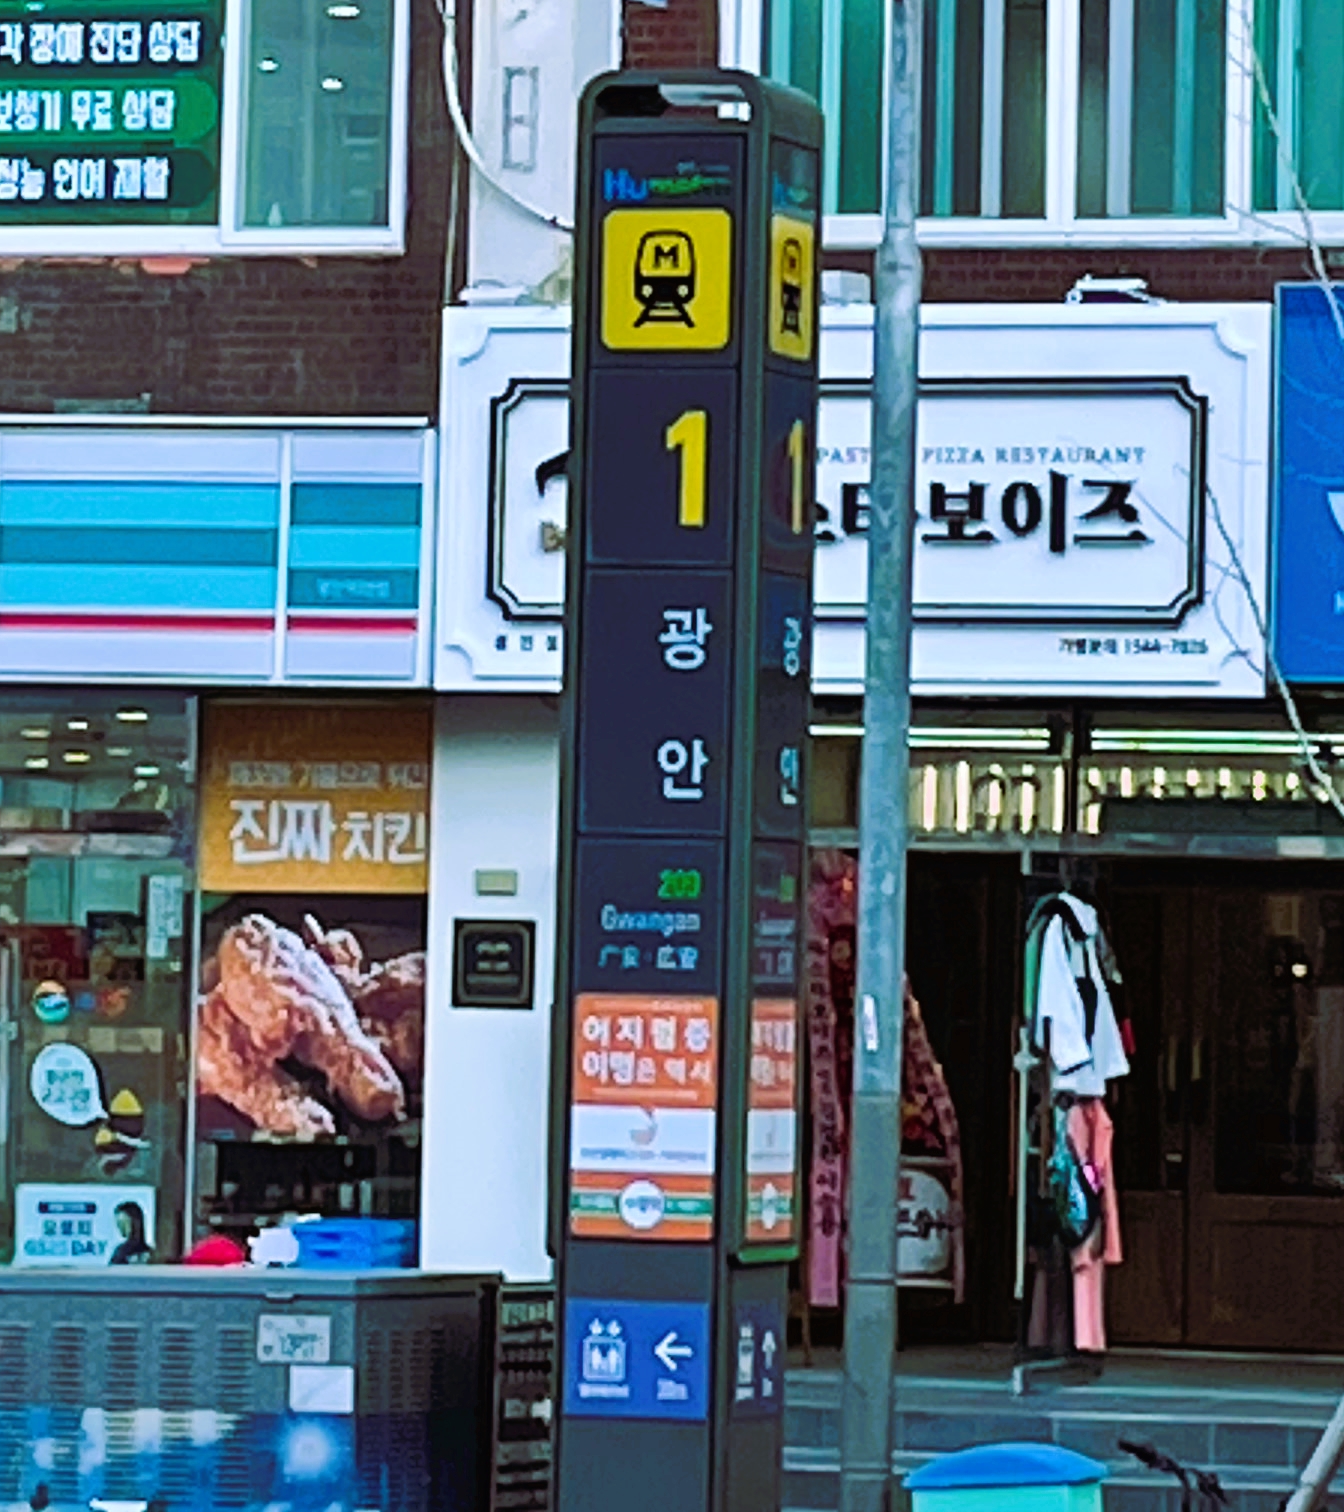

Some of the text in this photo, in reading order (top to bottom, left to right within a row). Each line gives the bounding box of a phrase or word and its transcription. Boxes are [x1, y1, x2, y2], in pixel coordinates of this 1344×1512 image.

[30, 20, 84, 65] 장애
[90, 20, 142, 64] 진단
[149, 19, 202, 64] 상담
[70, 89, 113, 133] 무료
[122, 89, 176, 133] 상담
[53, 157, 107, 201] 언어
[664, 408, 708, 528] 1
[816, 445, 1147, 465] PAST PIZZA RESTAURANT
[657, 606, 713, 801] 광안
[229, 798, 428, 866] 진짜 치킨
